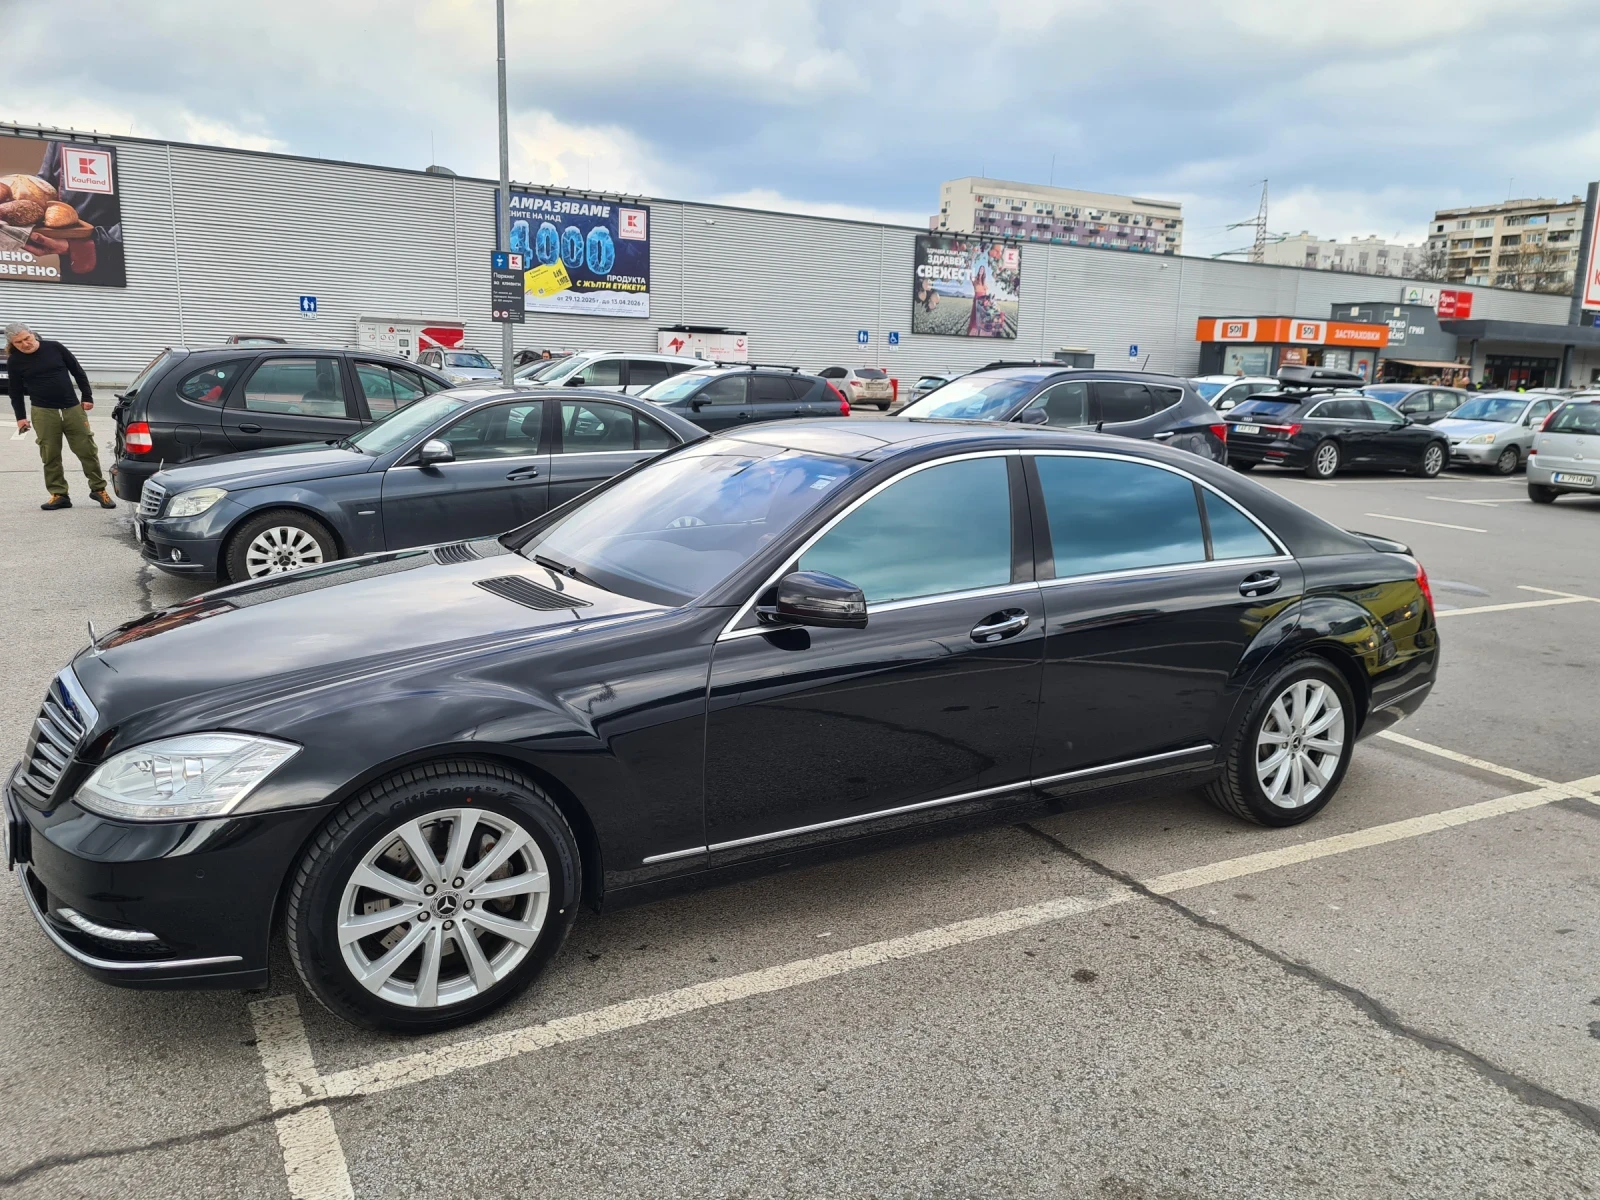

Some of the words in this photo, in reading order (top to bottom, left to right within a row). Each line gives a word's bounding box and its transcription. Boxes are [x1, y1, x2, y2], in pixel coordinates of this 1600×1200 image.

[71, 176, 106, 186] Kaufland
[509, 196, 610, 218] АМРАЗЯВАМЕ
[544, 214, 561, 223] НАД
[510, 220, 615, 275] 4000
[606, 275, 646, 284] ПРОДУКТА
[583, 281, 611, 289] ЖЪЛТИ
[613, 283, 646, 291] ЕТИКЕТИ
[1334, 329, 1381, 341] ЗАСТРАХОВКИ
